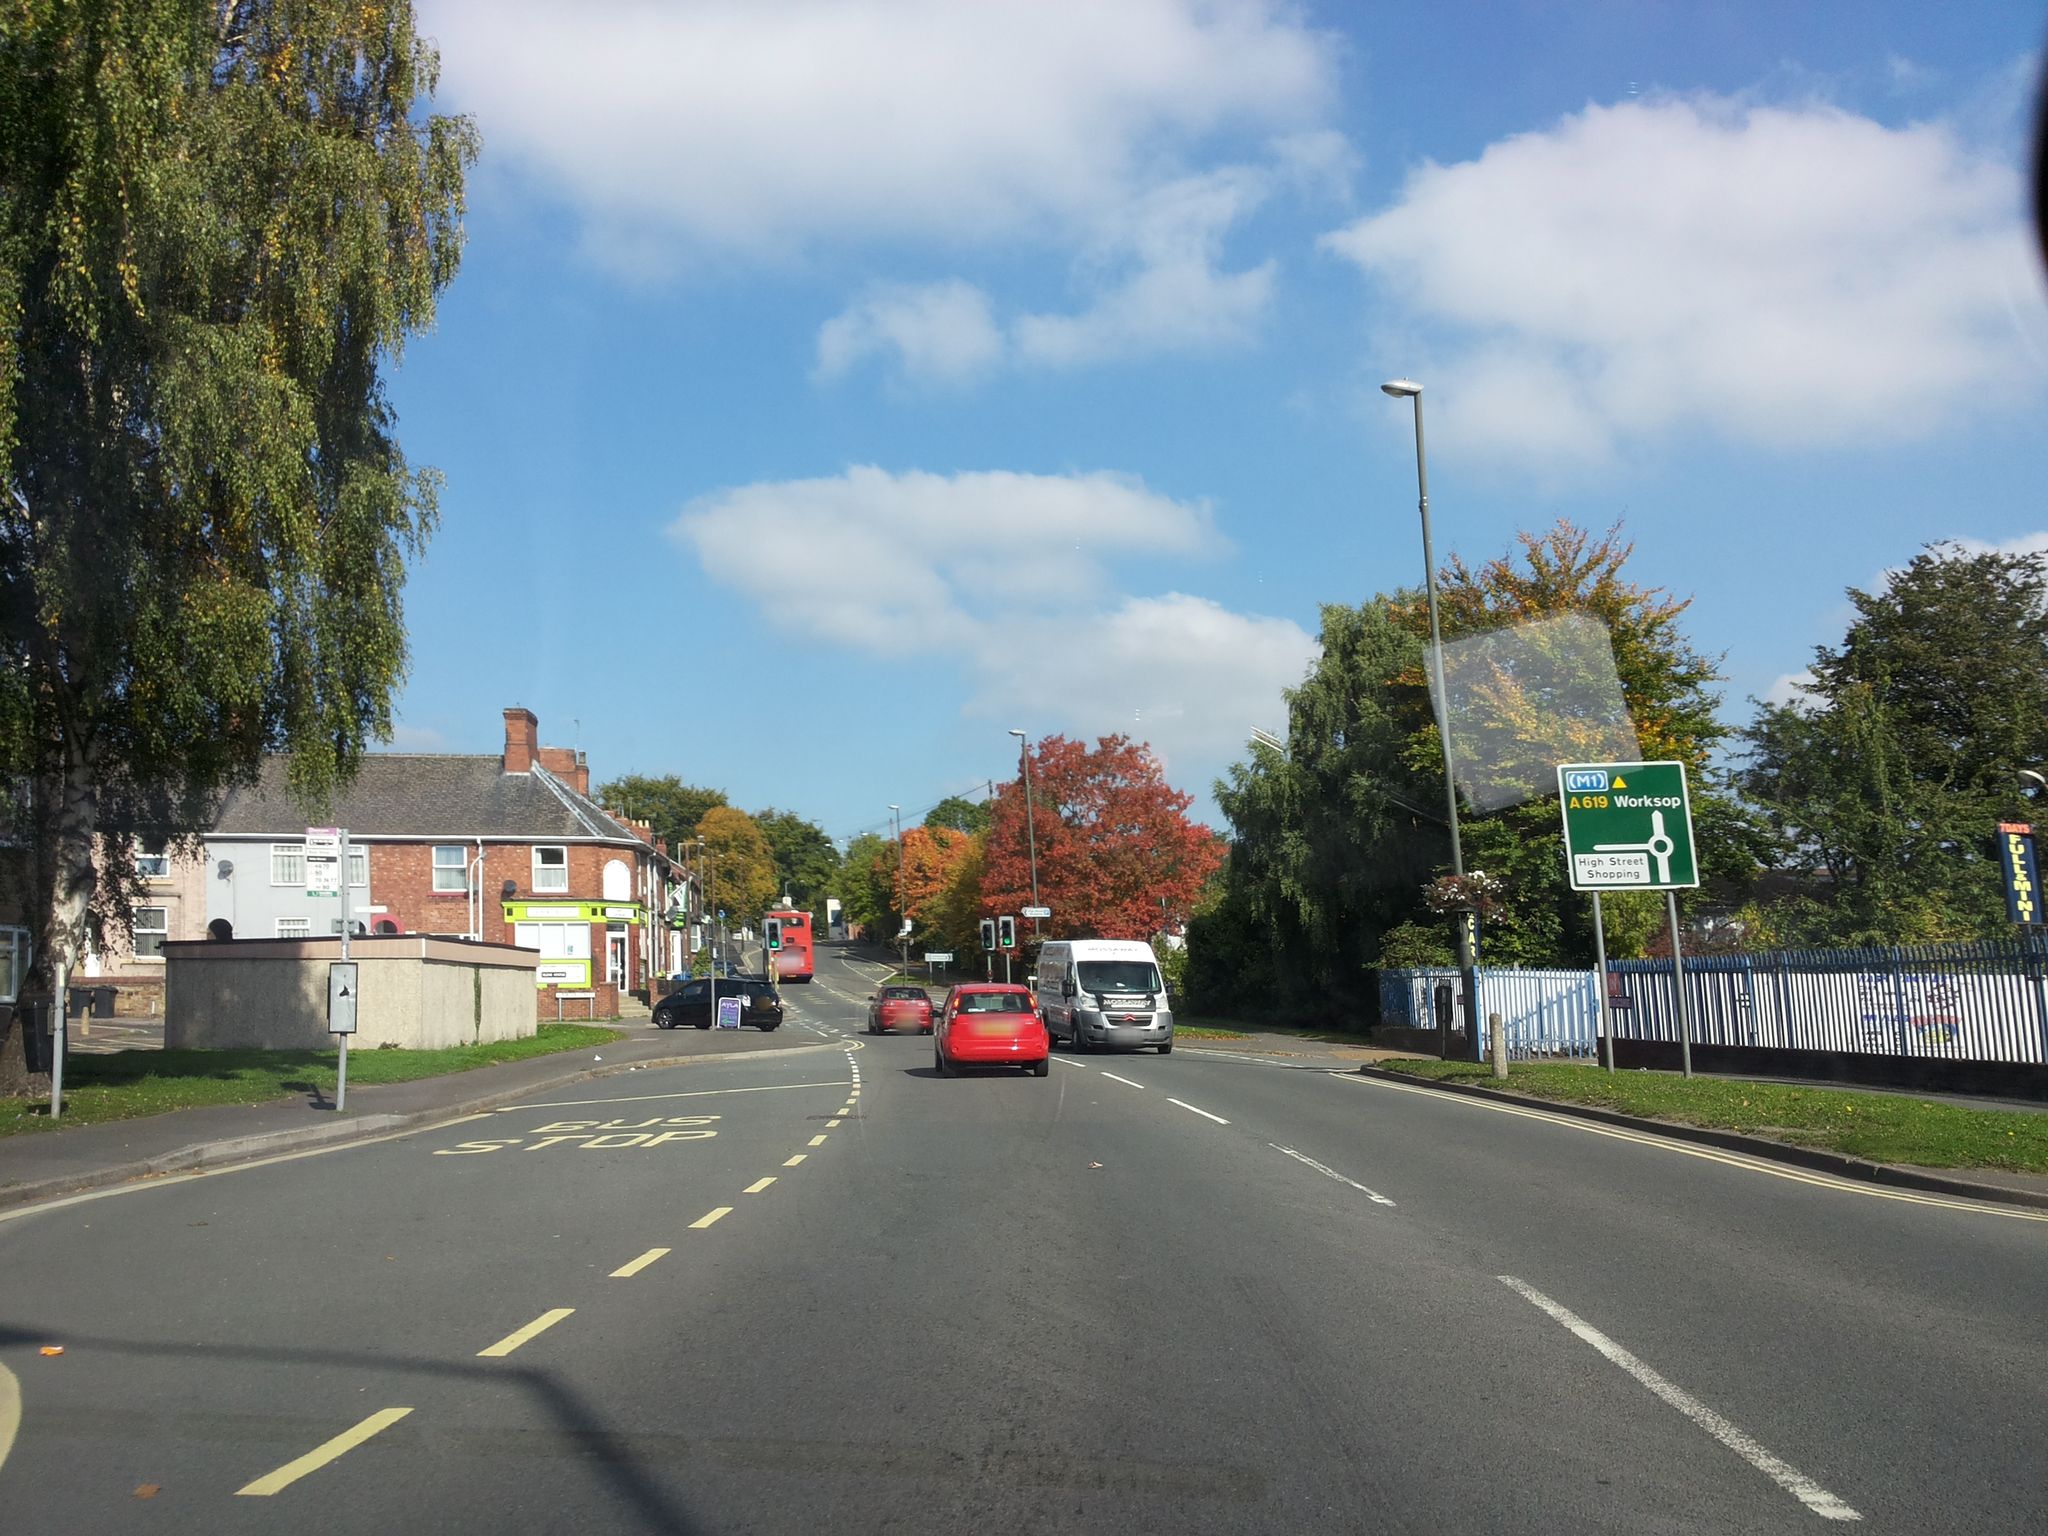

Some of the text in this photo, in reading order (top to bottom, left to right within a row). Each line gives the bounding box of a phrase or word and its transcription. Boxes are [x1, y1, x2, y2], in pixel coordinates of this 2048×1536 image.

[1569, 774, 1605, 788] (M1)
[1614, 795, 1682, 809] Worksop
[1578, 857, 1645, 868] High Street
[1587, 869, 1641, 880] Shopping
[528, 1115, 722, 1133] BUS
[432, 1131, 718, 1155] STOP
